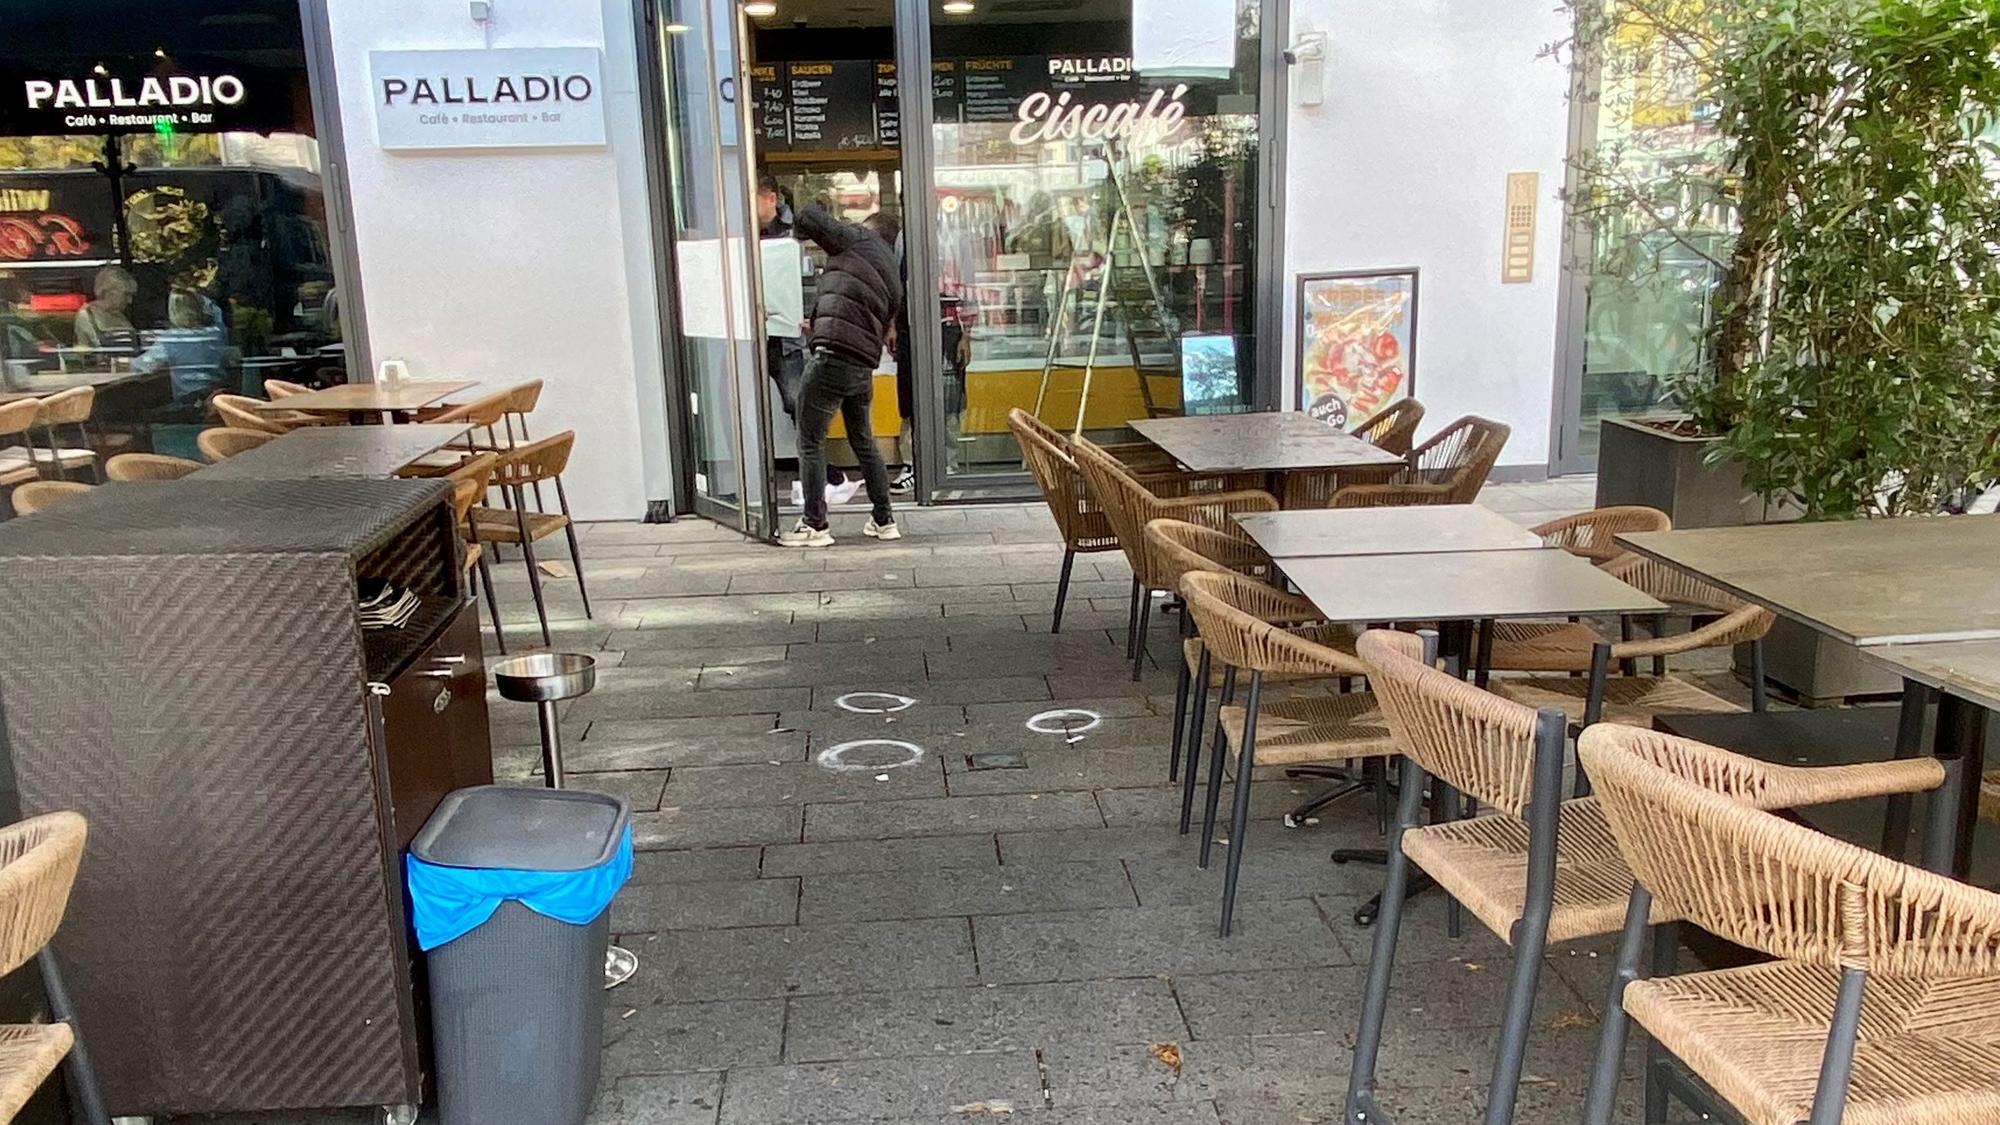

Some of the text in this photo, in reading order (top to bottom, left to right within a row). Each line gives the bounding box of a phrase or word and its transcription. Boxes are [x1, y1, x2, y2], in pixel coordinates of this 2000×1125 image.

[1048, 57, 1136, 75] PALLADI
[25, 75, 245, 109] PALLADIO
[382, 74, 593, 106] PALLADIO
[65, 112, 213, 128] Café Restaurant Bar
[419, 112, 561, 126] Café Restaurant Bar
[1009, 83, 1188, 149] Eiscafé
[1311, 397, 1342, 418] auch
[1326, 412, 1345, 427] Go
